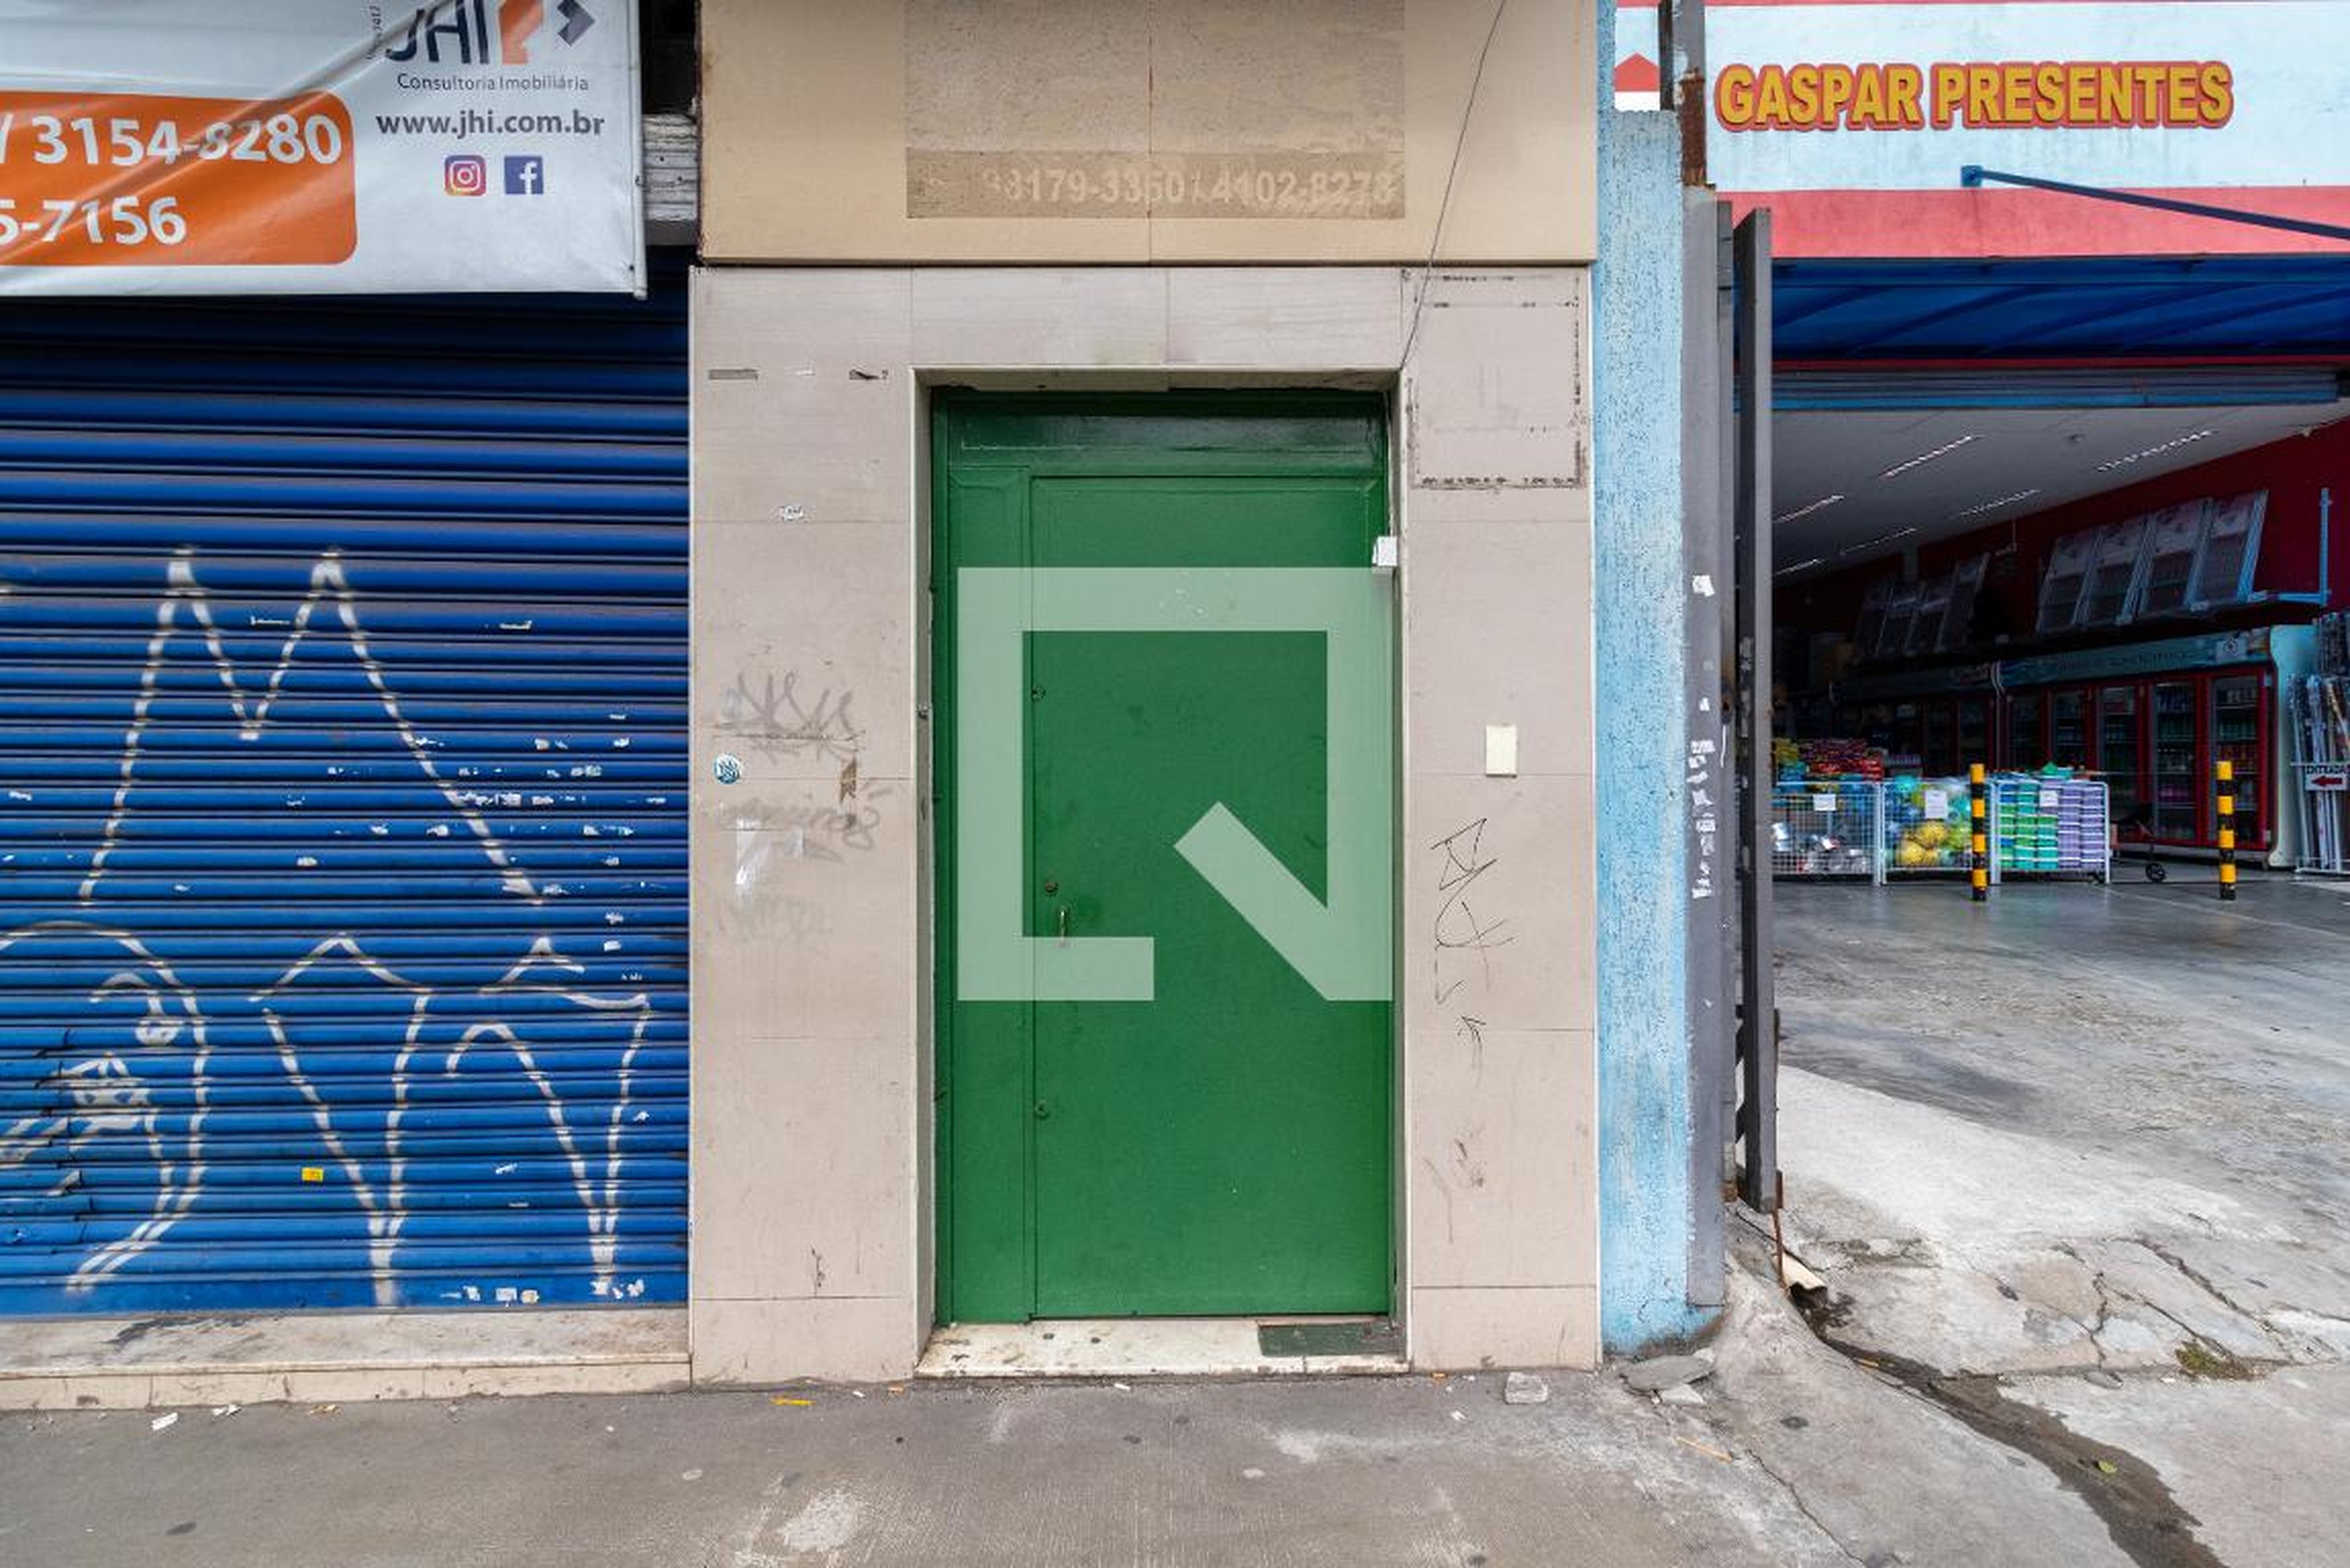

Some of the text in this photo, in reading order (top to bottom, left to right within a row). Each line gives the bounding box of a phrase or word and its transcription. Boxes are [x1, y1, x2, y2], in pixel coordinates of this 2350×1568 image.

[397, 73, 589, 91] Consultoria Imobiliária
[1717, 61, 2234, 130] GASPAR PRESENTES
[32, 113, 342, 165] 3154-8280
[376, 109, 605, 139] www.jhi.com.br
